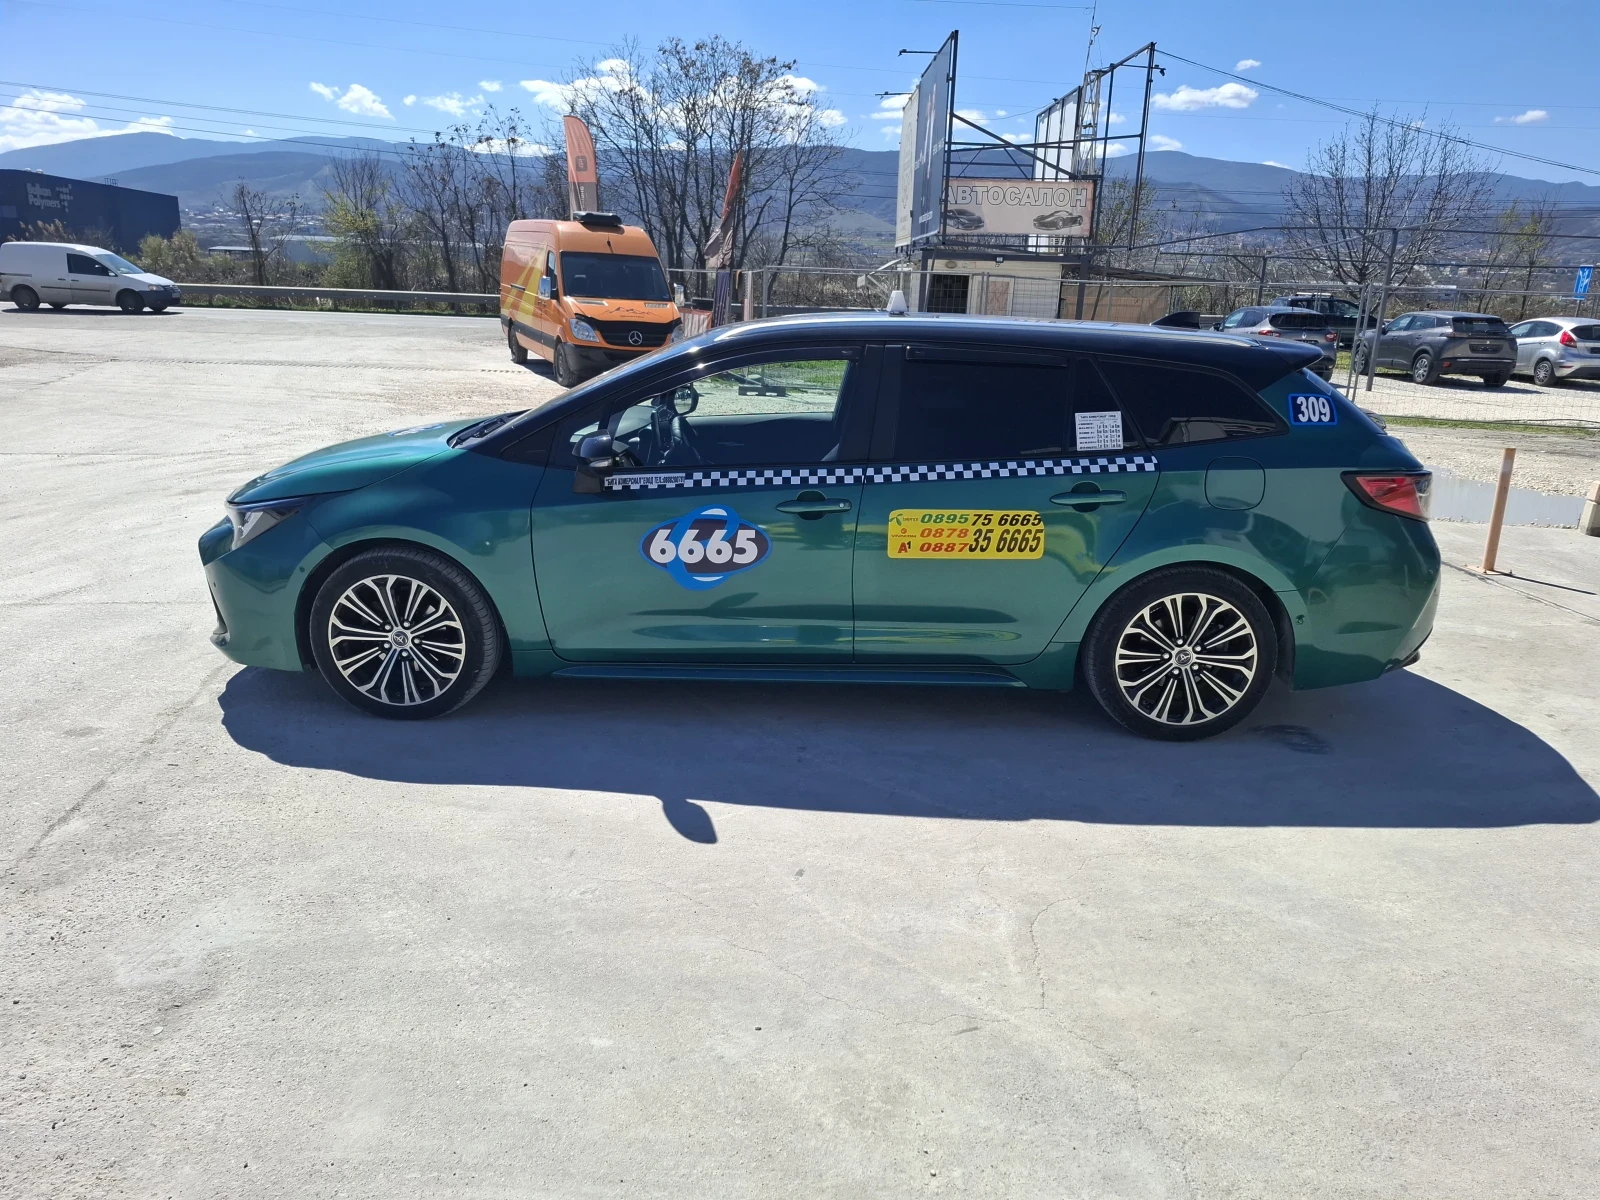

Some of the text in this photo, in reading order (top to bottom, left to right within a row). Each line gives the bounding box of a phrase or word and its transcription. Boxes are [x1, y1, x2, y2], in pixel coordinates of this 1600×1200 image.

[27, 182, 51, 197] Balkan
[28, 194, 61, 210] Polymers
[1296, 396, 1331, 423] 309
[920, 513, 970, 524] 0895
[971, 513, 994, 527] 75
[997, 513, 1042, 527] 6665
[919, 527, 969, 539] 0878
[968, 528, 1045, 553] 35 6665
[649, 529, 758, 564] 6665
[919, 542, 970, 553] 0887
